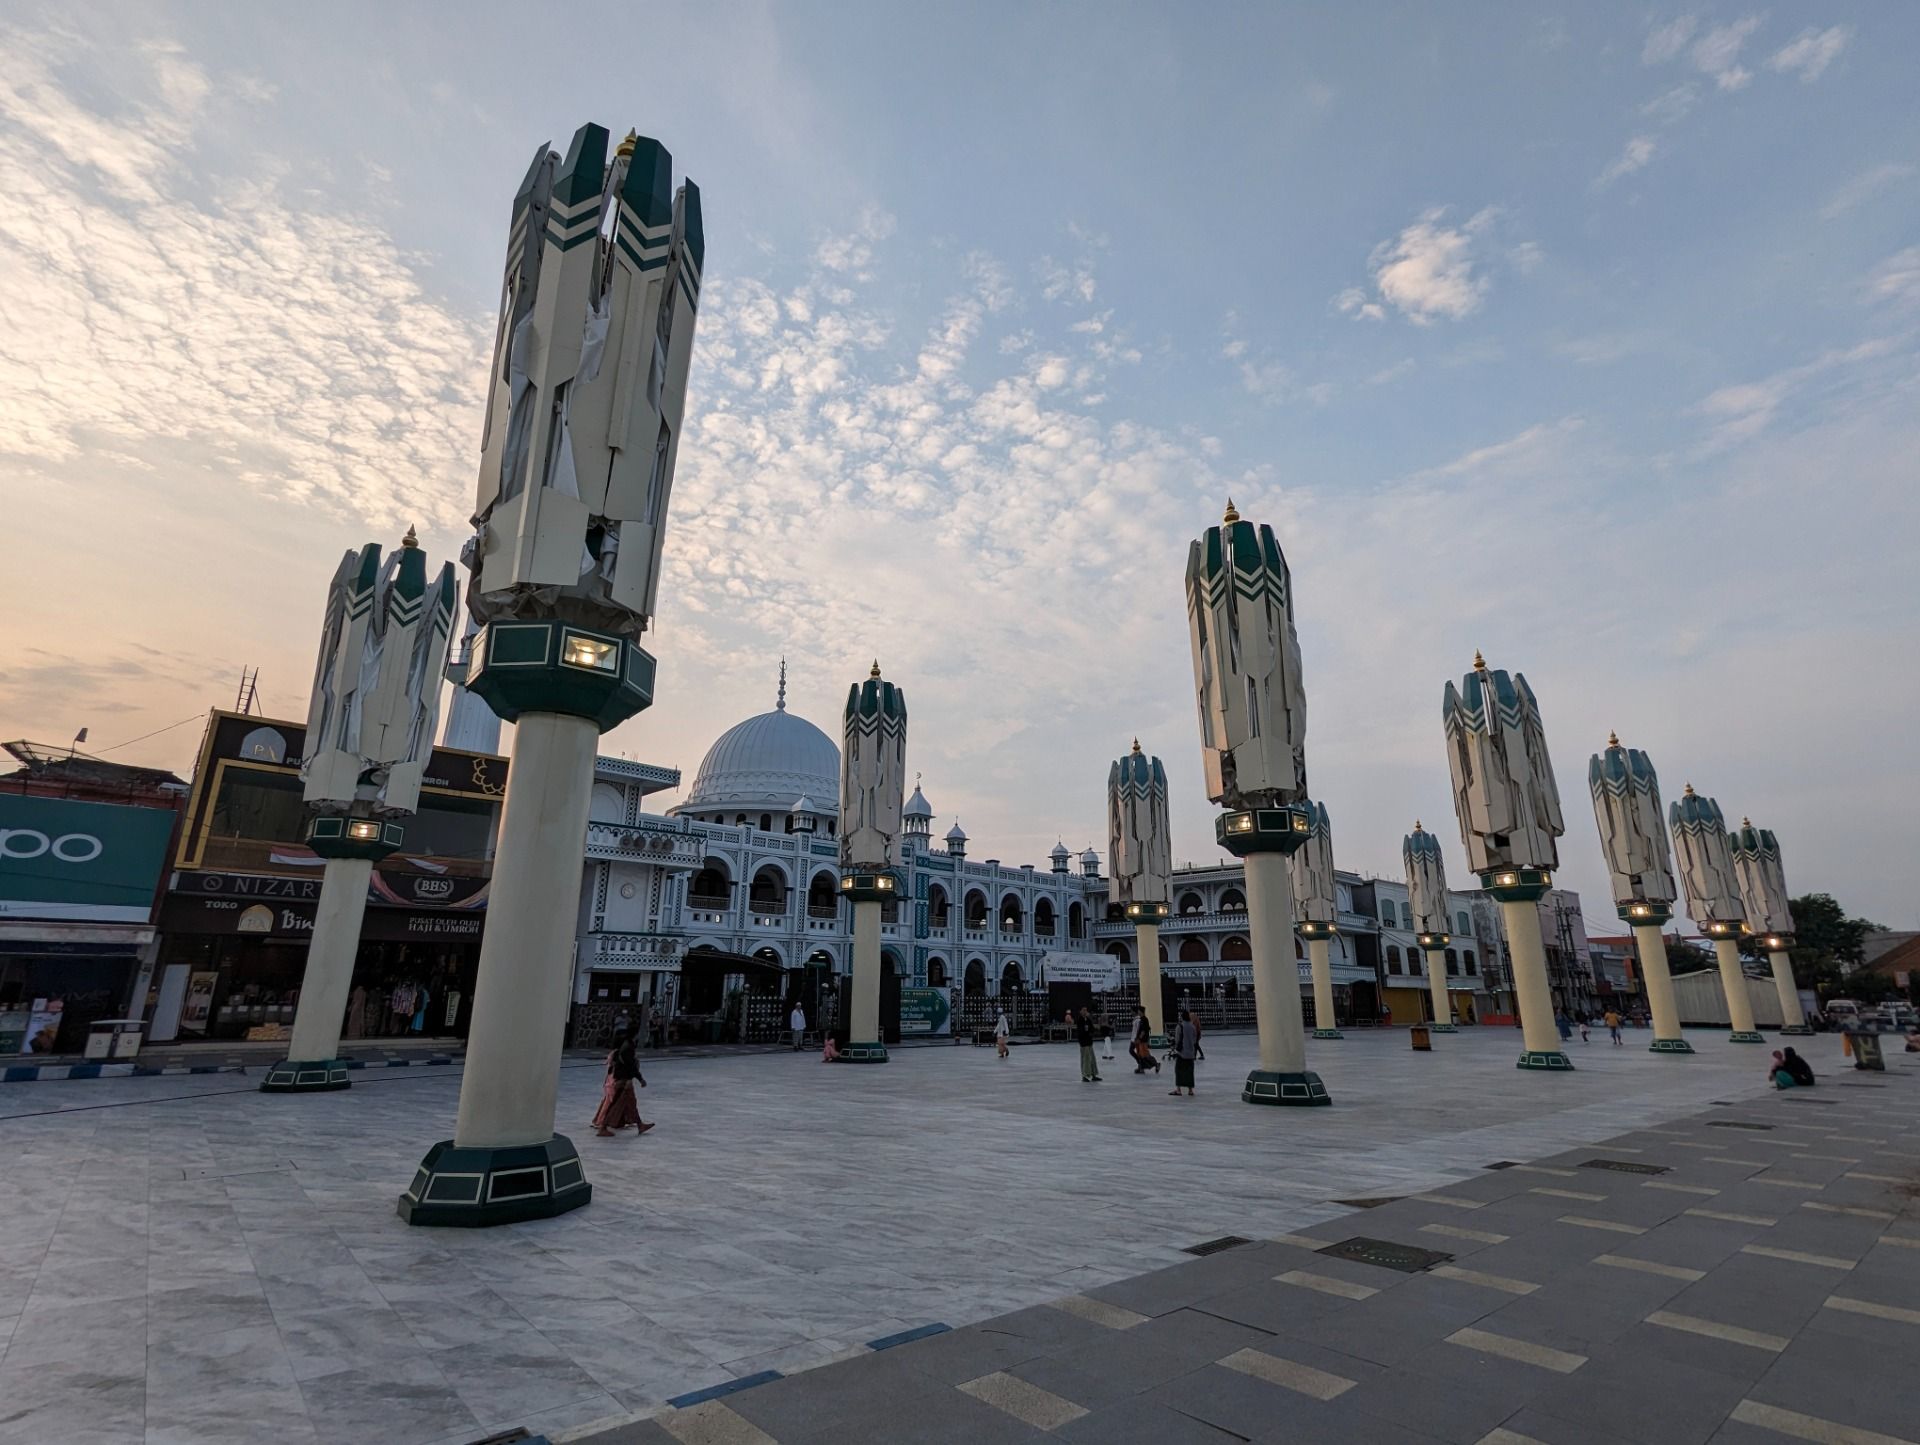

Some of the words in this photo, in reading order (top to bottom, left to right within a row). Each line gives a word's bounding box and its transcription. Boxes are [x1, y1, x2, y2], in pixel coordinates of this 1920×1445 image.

[234, 877, 315, 897] NIZAR
[420, 880, 449, 892] BHS
[205, 900, 238, 909] TOKO
[409, 917, 435, 925] PUSAT
[435, 918, 457, 926] OLEH
[408, 923, 433, 933] HAJI
[442, 924, 480, 934] UMROH
